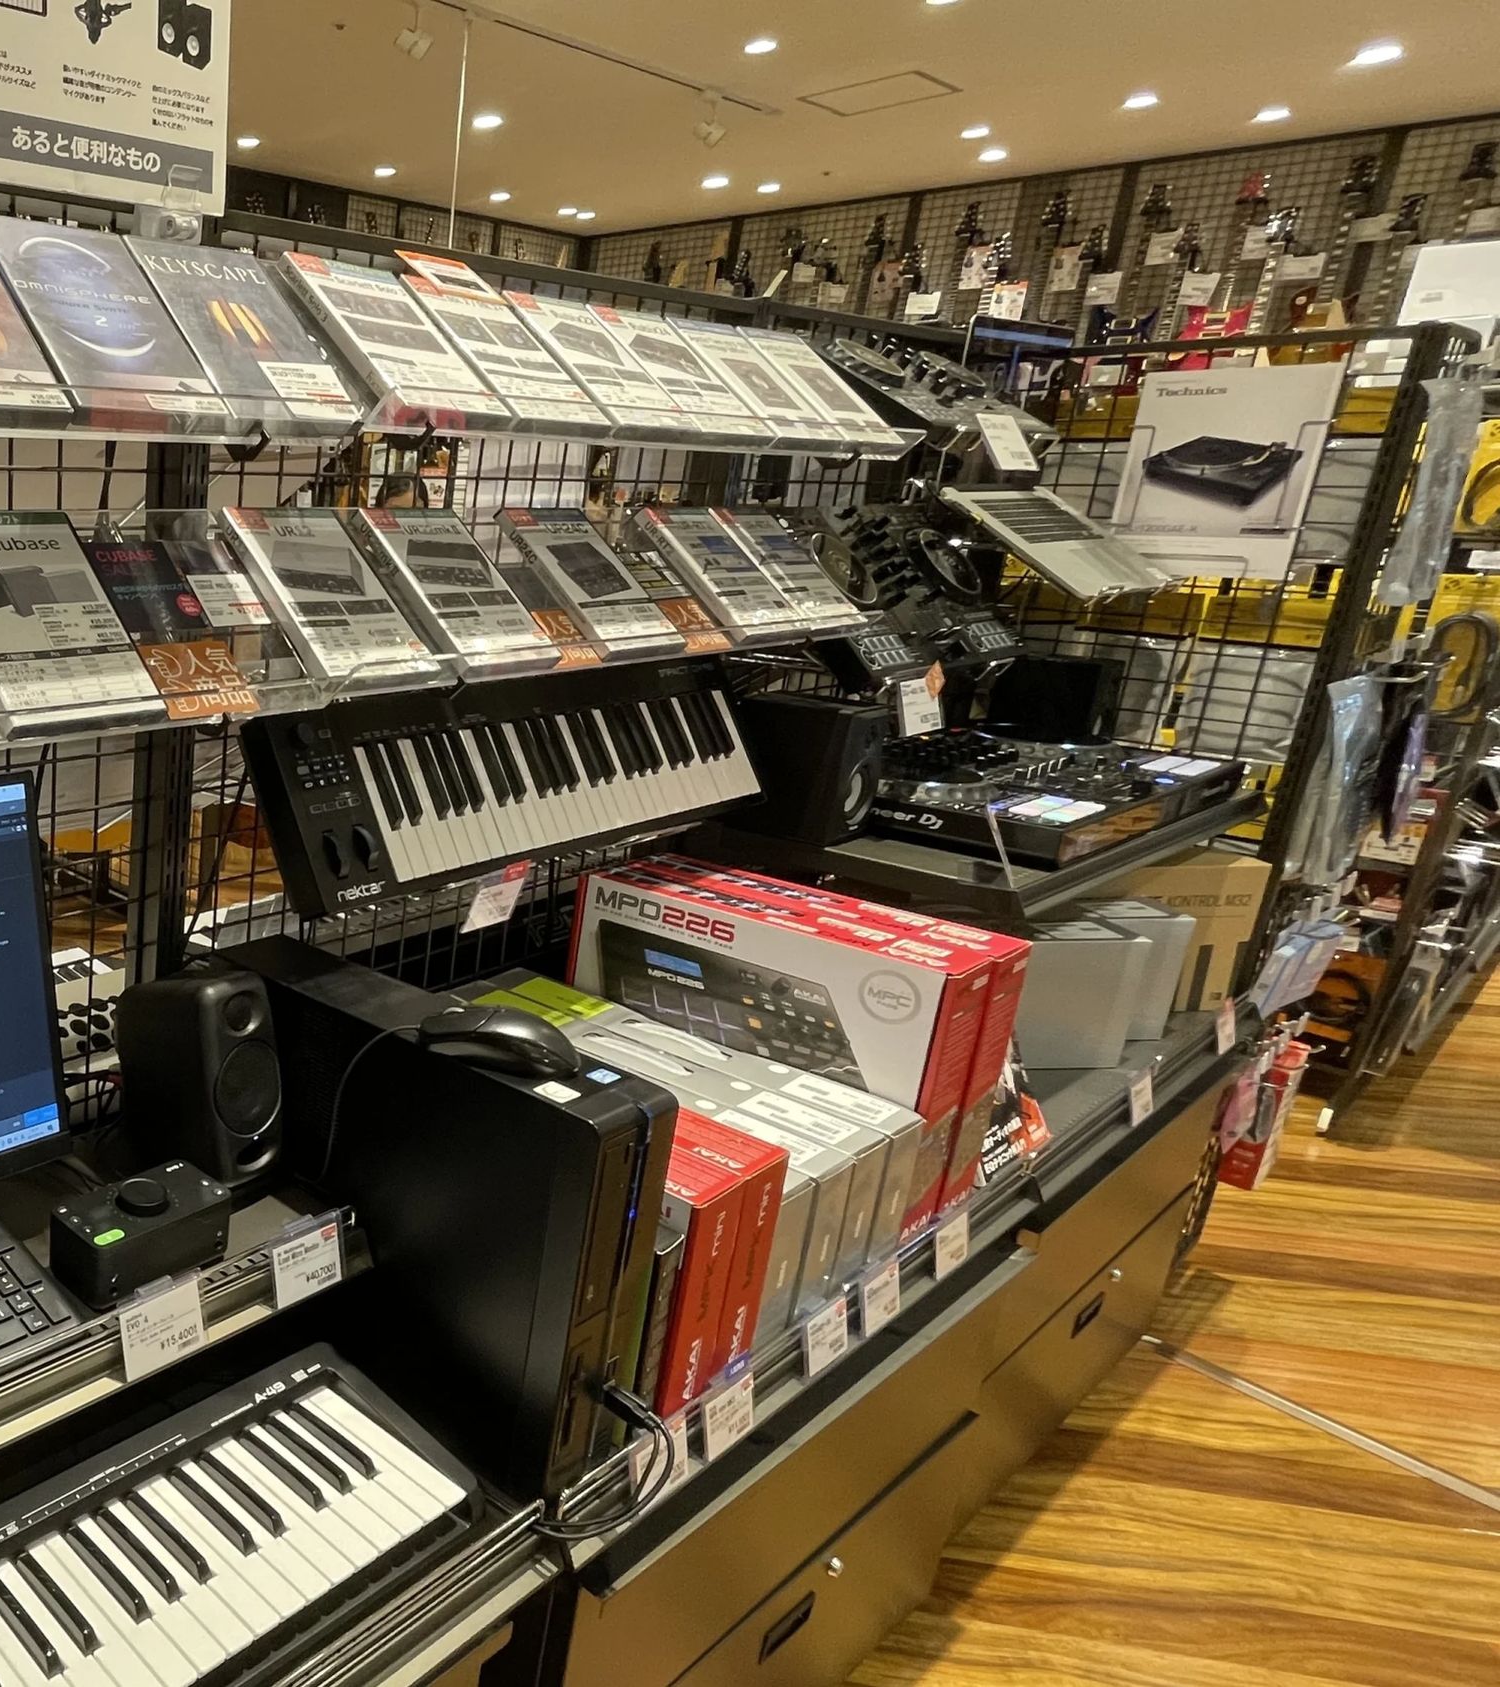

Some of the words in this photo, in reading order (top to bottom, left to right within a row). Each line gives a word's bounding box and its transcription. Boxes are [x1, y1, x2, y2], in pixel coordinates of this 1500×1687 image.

[11, 125, 161, 173] あると便利なもの
[144, 253, 268, 286] KEYSCAPE
[14, 279, 152, 306] OMNISPHERE
[1155, 386, 1228, 399] Technics
[95, 549, 157, 562] CUBASE
[509, 531, 538, 566] UR24C
[188, 646, 238, 675] 人気
[337, 879, 386, 903] nektar
[1167, 894, 1222, 908] KONTROL
[1224, 893, 1254, 907] M32
[595, 886, 736, 943] MPD226
[794, 989, 828, 1006] AKAI
[867, 985, 912, 1008] MPC
[694, 1144, 746, 1170] AKAI
[901, 1210, 931, 1242] AKAI
[126, 1319, 141, 1333] EVO
[728, 1304, 748, 1363] AKAI
[683, 1338, 700, 1400] AKAI
